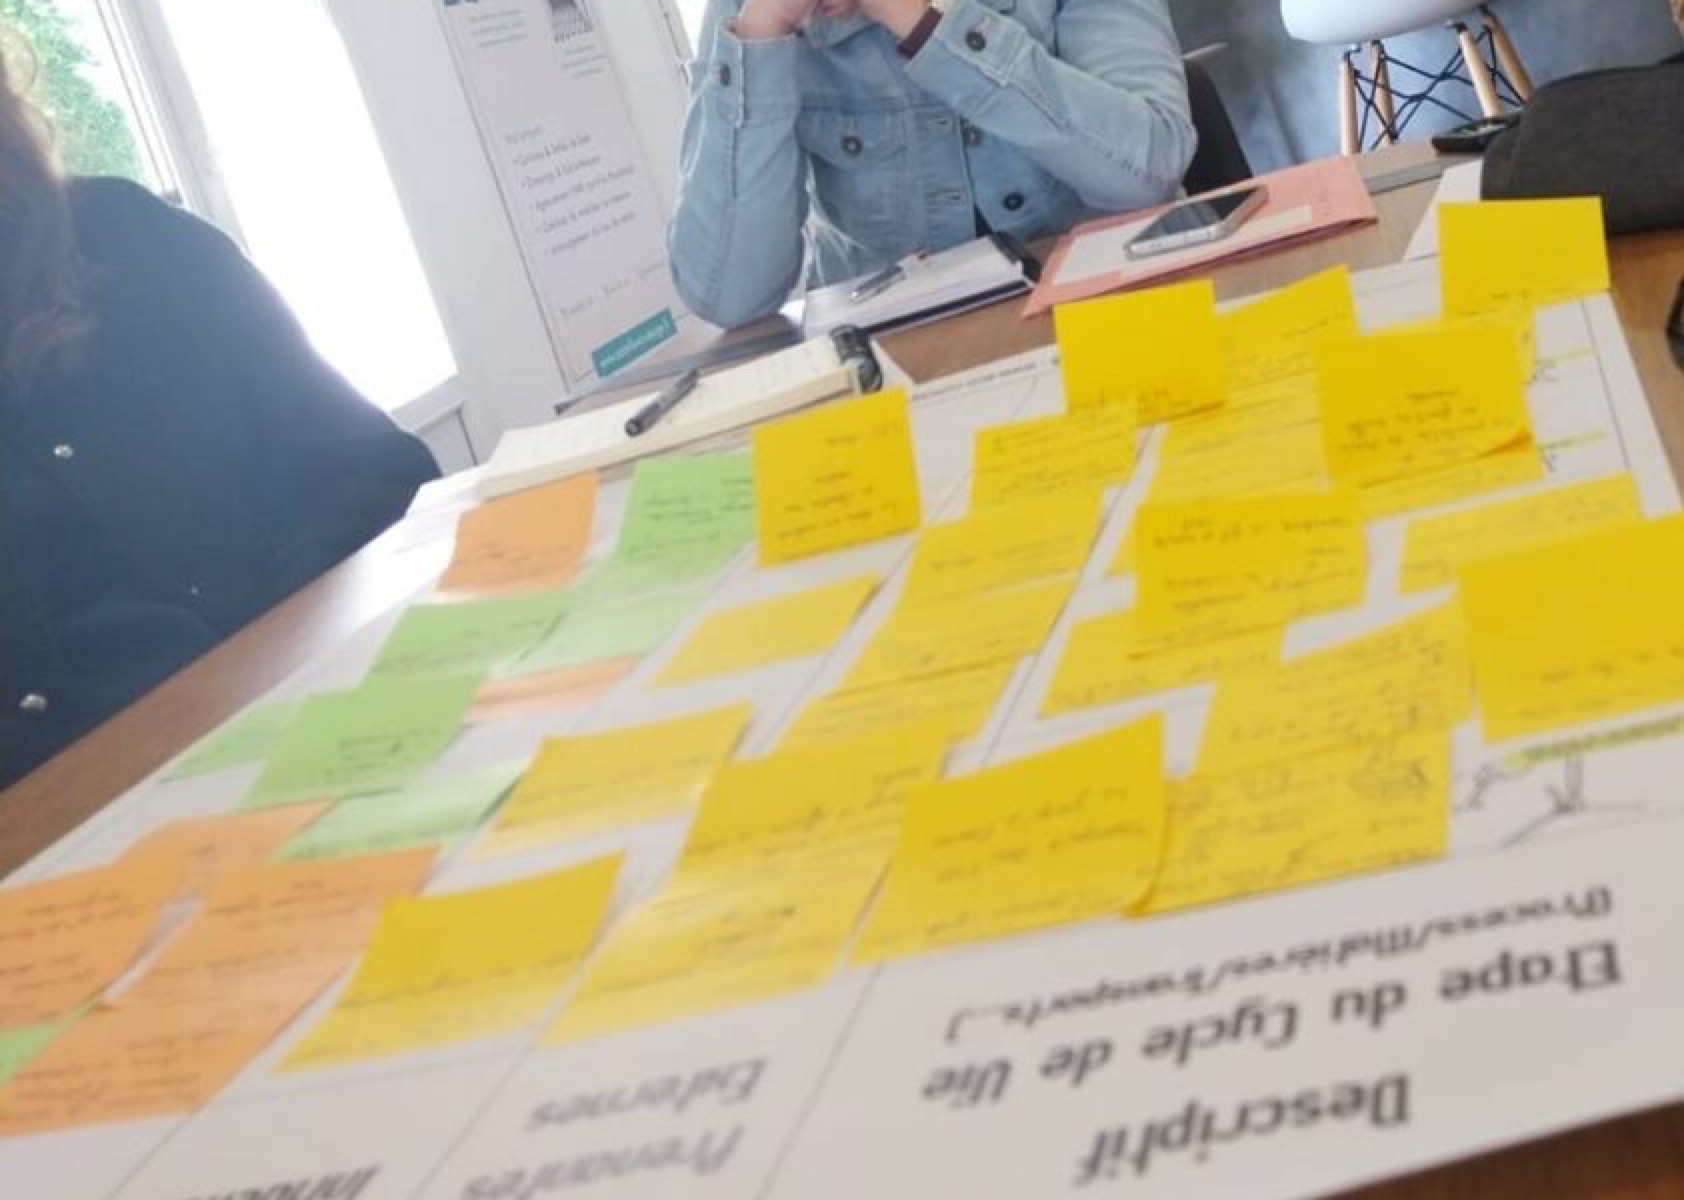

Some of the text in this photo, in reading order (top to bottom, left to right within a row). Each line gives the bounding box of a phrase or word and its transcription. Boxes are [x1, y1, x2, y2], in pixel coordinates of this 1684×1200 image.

[1330, 979, 1407, 1030] du
[1141, 997, 1299, 1068] Cycle
[920, 1057, 1013, 1106] Vie
[1039, 1037, 1114, 1086] de
[1073, 1071, 1410, 1186] Descriptif
